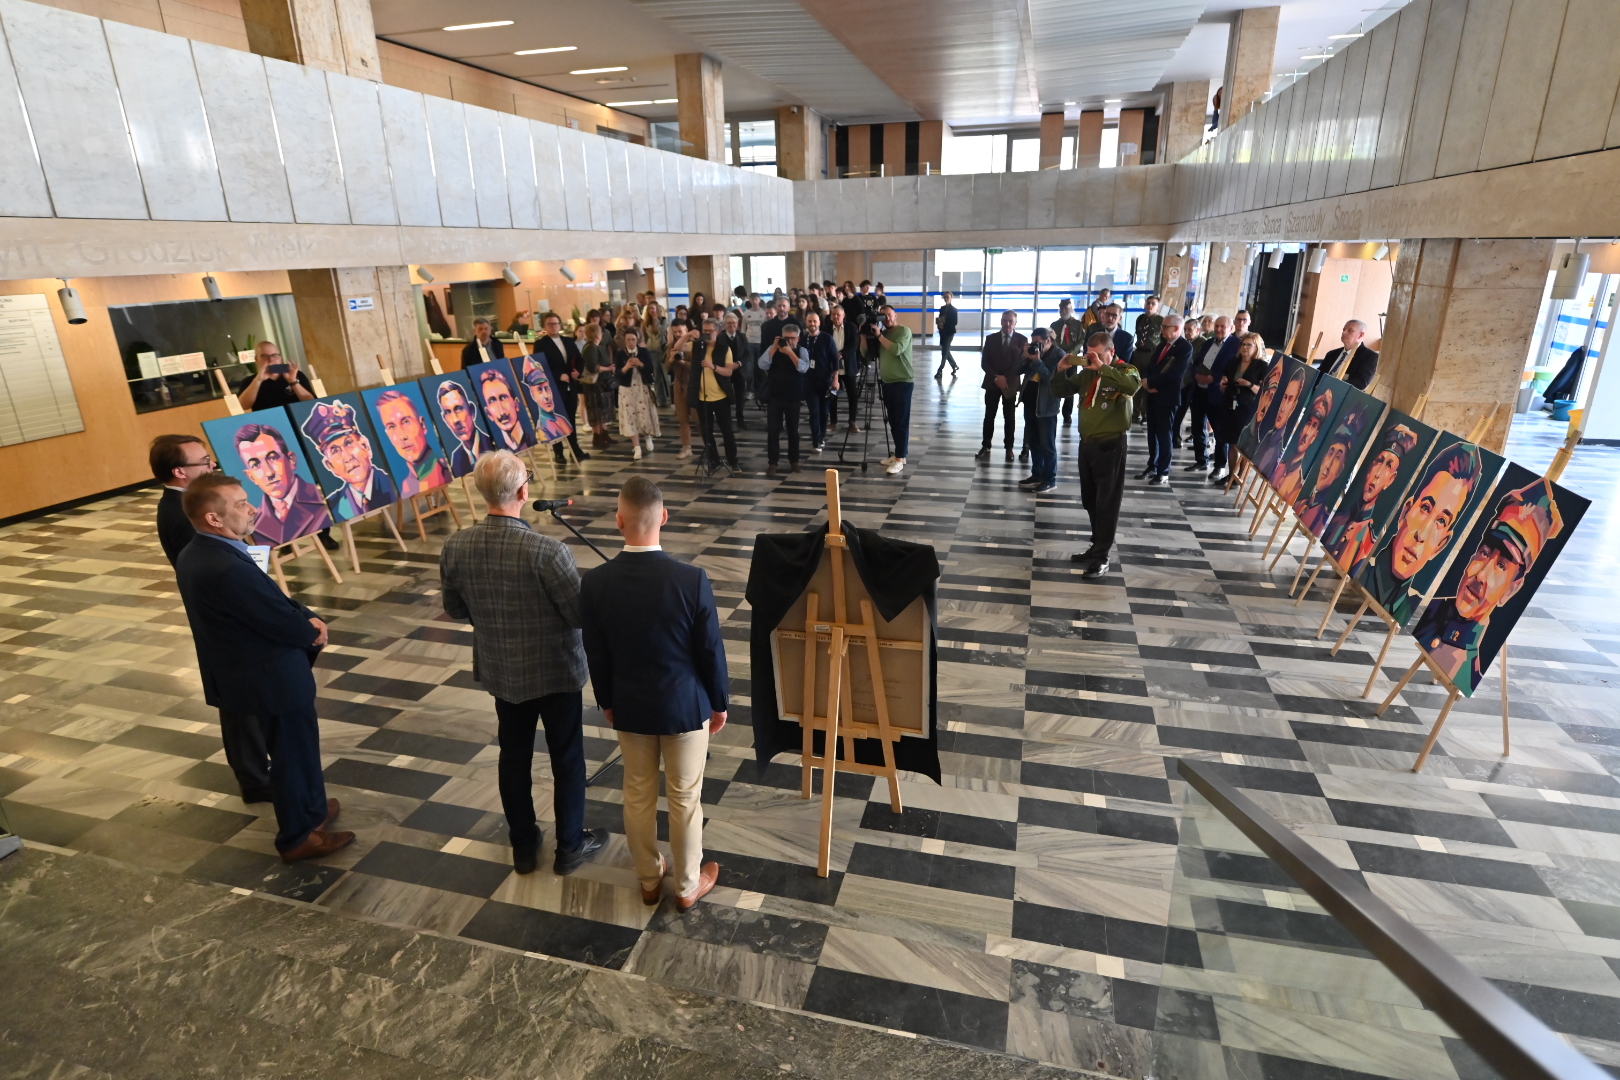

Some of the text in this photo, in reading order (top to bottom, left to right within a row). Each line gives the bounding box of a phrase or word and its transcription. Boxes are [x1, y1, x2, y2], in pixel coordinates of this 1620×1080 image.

[1262, 214, 1282, 239] Słupca
[1287, 207, 1326, 238] Szamotuły
[1332, 198, 1363, 231] Środa
[1367, 189, 1461, 236] Wielkopolska
[74, 232, 230, 267] Grodzisk
[1449, 629, 1461, 642] 12
